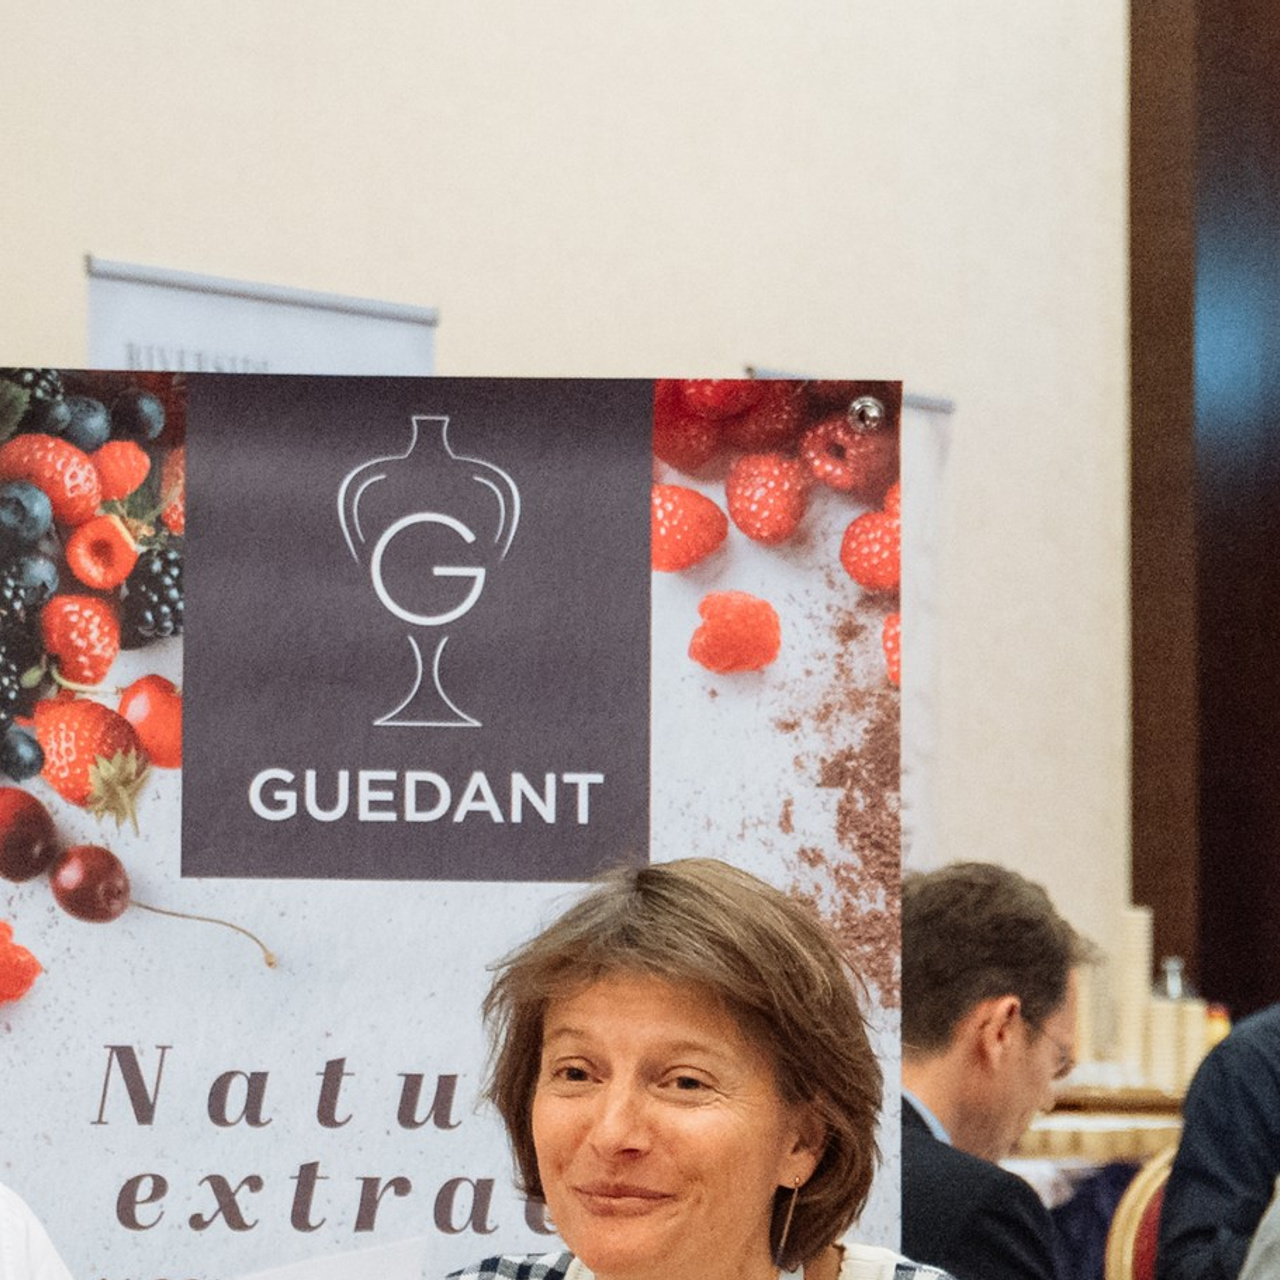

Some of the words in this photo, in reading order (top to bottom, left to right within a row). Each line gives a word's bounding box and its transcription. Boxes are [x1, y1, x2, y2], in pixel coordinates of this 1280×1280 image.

[371, 512, 486, 626] G
[249, 768, 604, 824] GUEDANT
[91, 1044, 463, 1130] Natu
